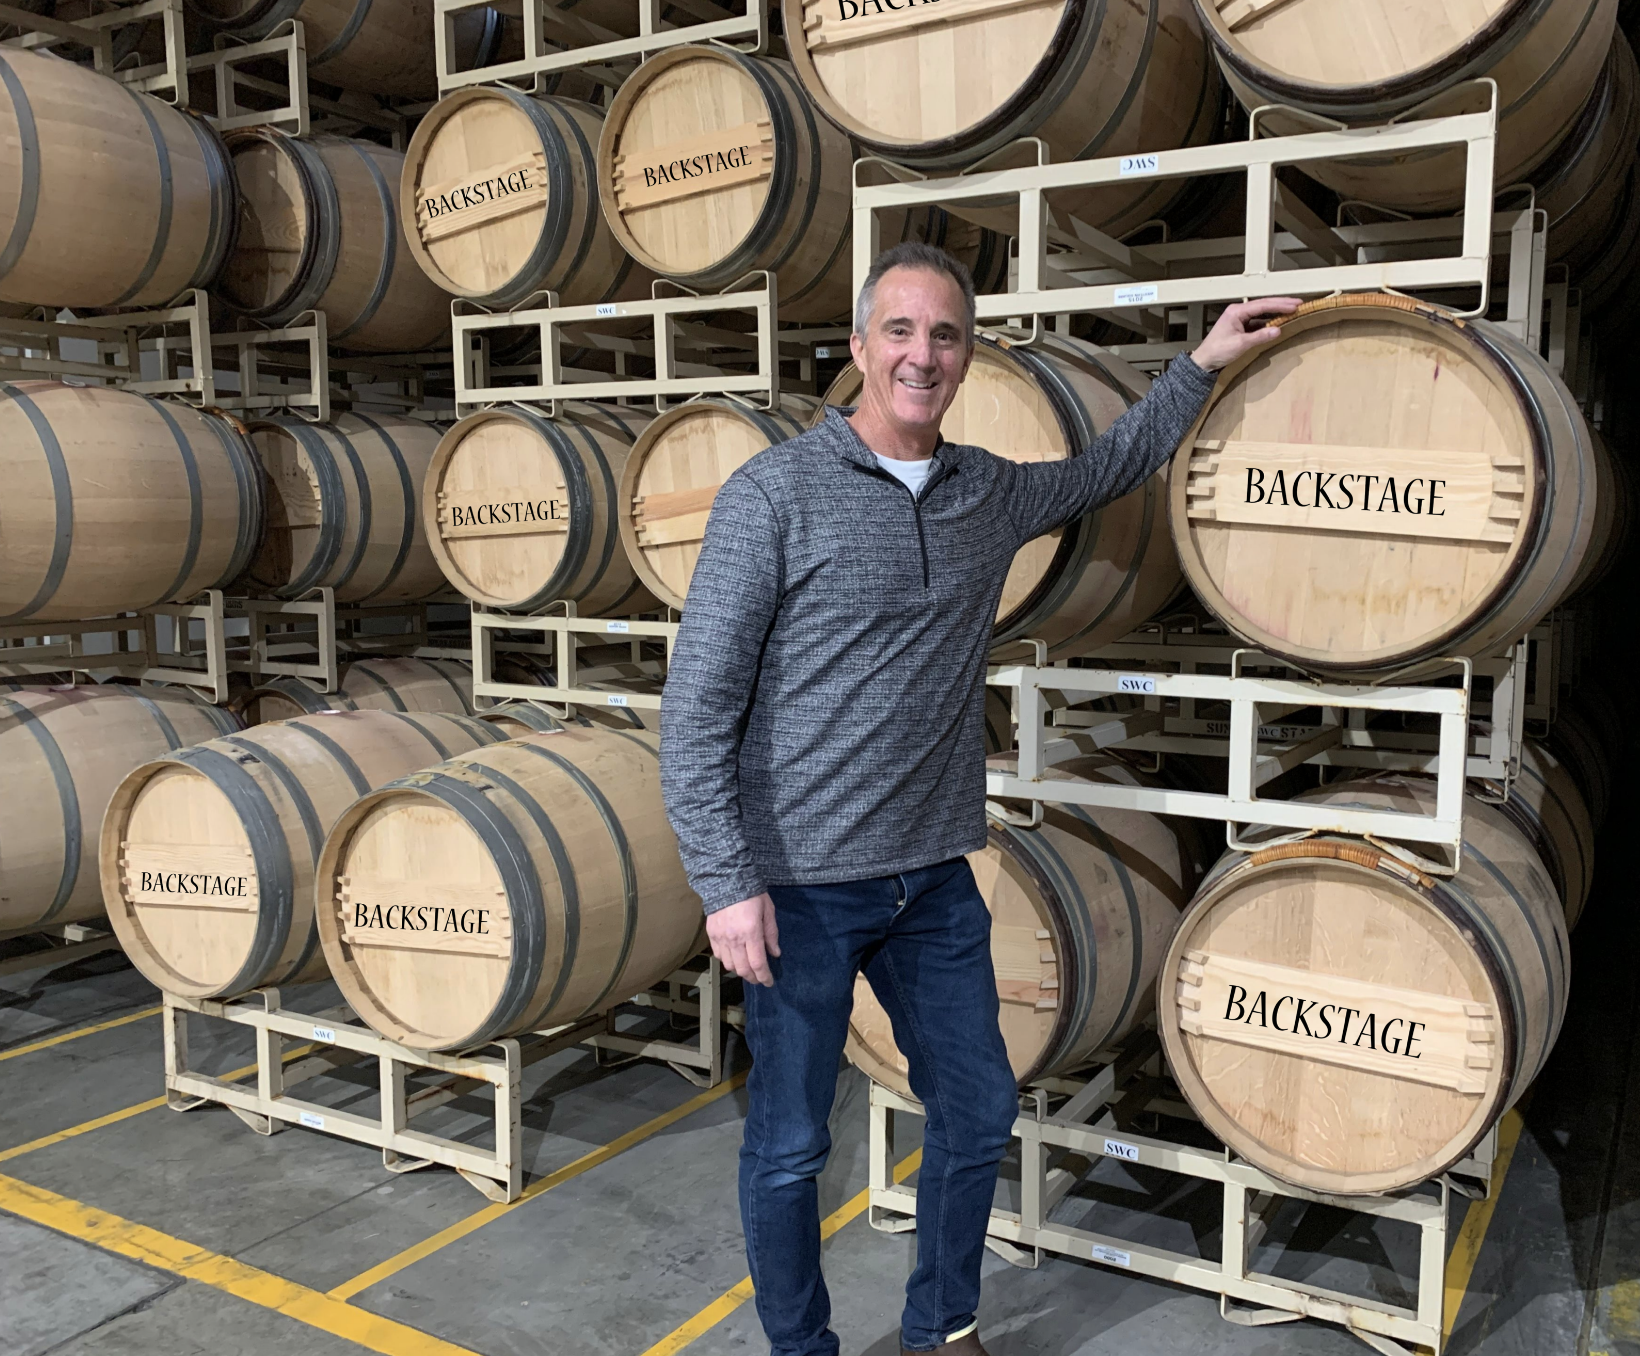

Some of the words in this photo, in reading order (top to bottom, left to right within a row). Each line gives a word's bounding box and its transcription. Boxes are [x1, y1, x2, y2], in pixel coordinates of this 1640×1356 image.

[643, 145, 752, 187] BACKSTAGE
[1122, 156, 1155, 171] SWC
[425, 169, 533, 218] BACKSTAGE
[597, 306, 614, 315] SWC
[1245, 467, 1447, 516] BACKSTAGE
[452, 499, 561, 527] BACKSTAGE
[1121, 679, 1153, 692] SWC
[609, 697, 623, 705] SWC
[141, 871, 247, 897] BACKSTAGE
[355, 903, 490, 934] BACKSTAGE
[1224, 984, 1427, 1058] BACKSTAGE
[314, 1029, 332, 1040] SWC
[1106, 1142, 1136, 1159] SWC
